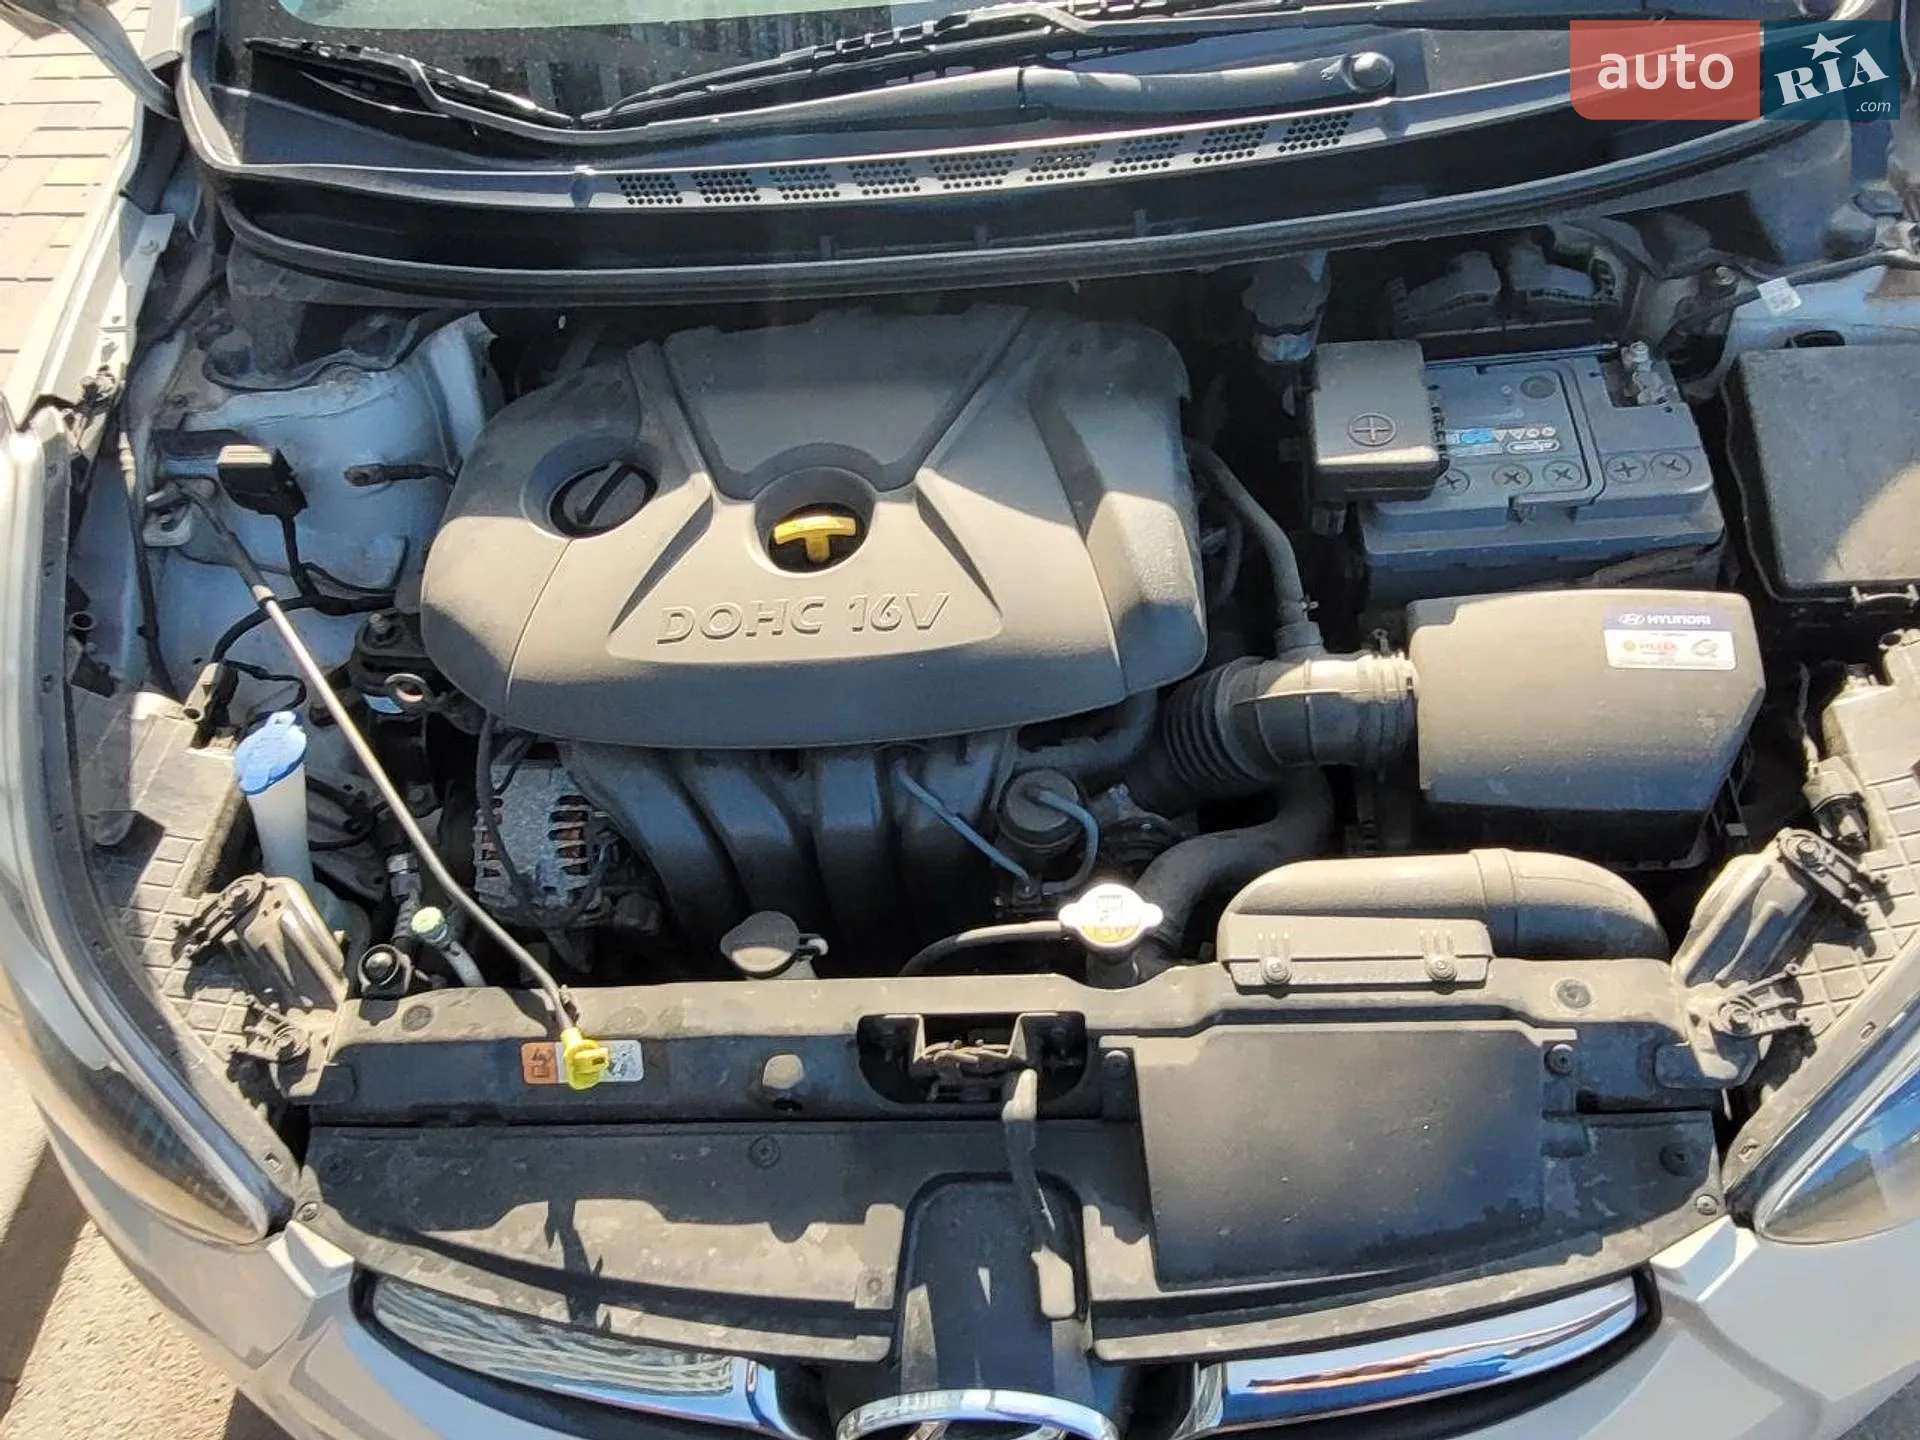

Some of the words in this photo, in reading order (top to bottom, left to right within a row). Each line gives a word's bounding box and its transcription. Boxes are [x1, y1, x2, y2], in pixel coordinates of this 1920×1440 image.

[656, 596, 827, 645] DOHC
[848, 592, 951, 633] 16V
[1647, 614, 1711, 626] HYUNDAI
